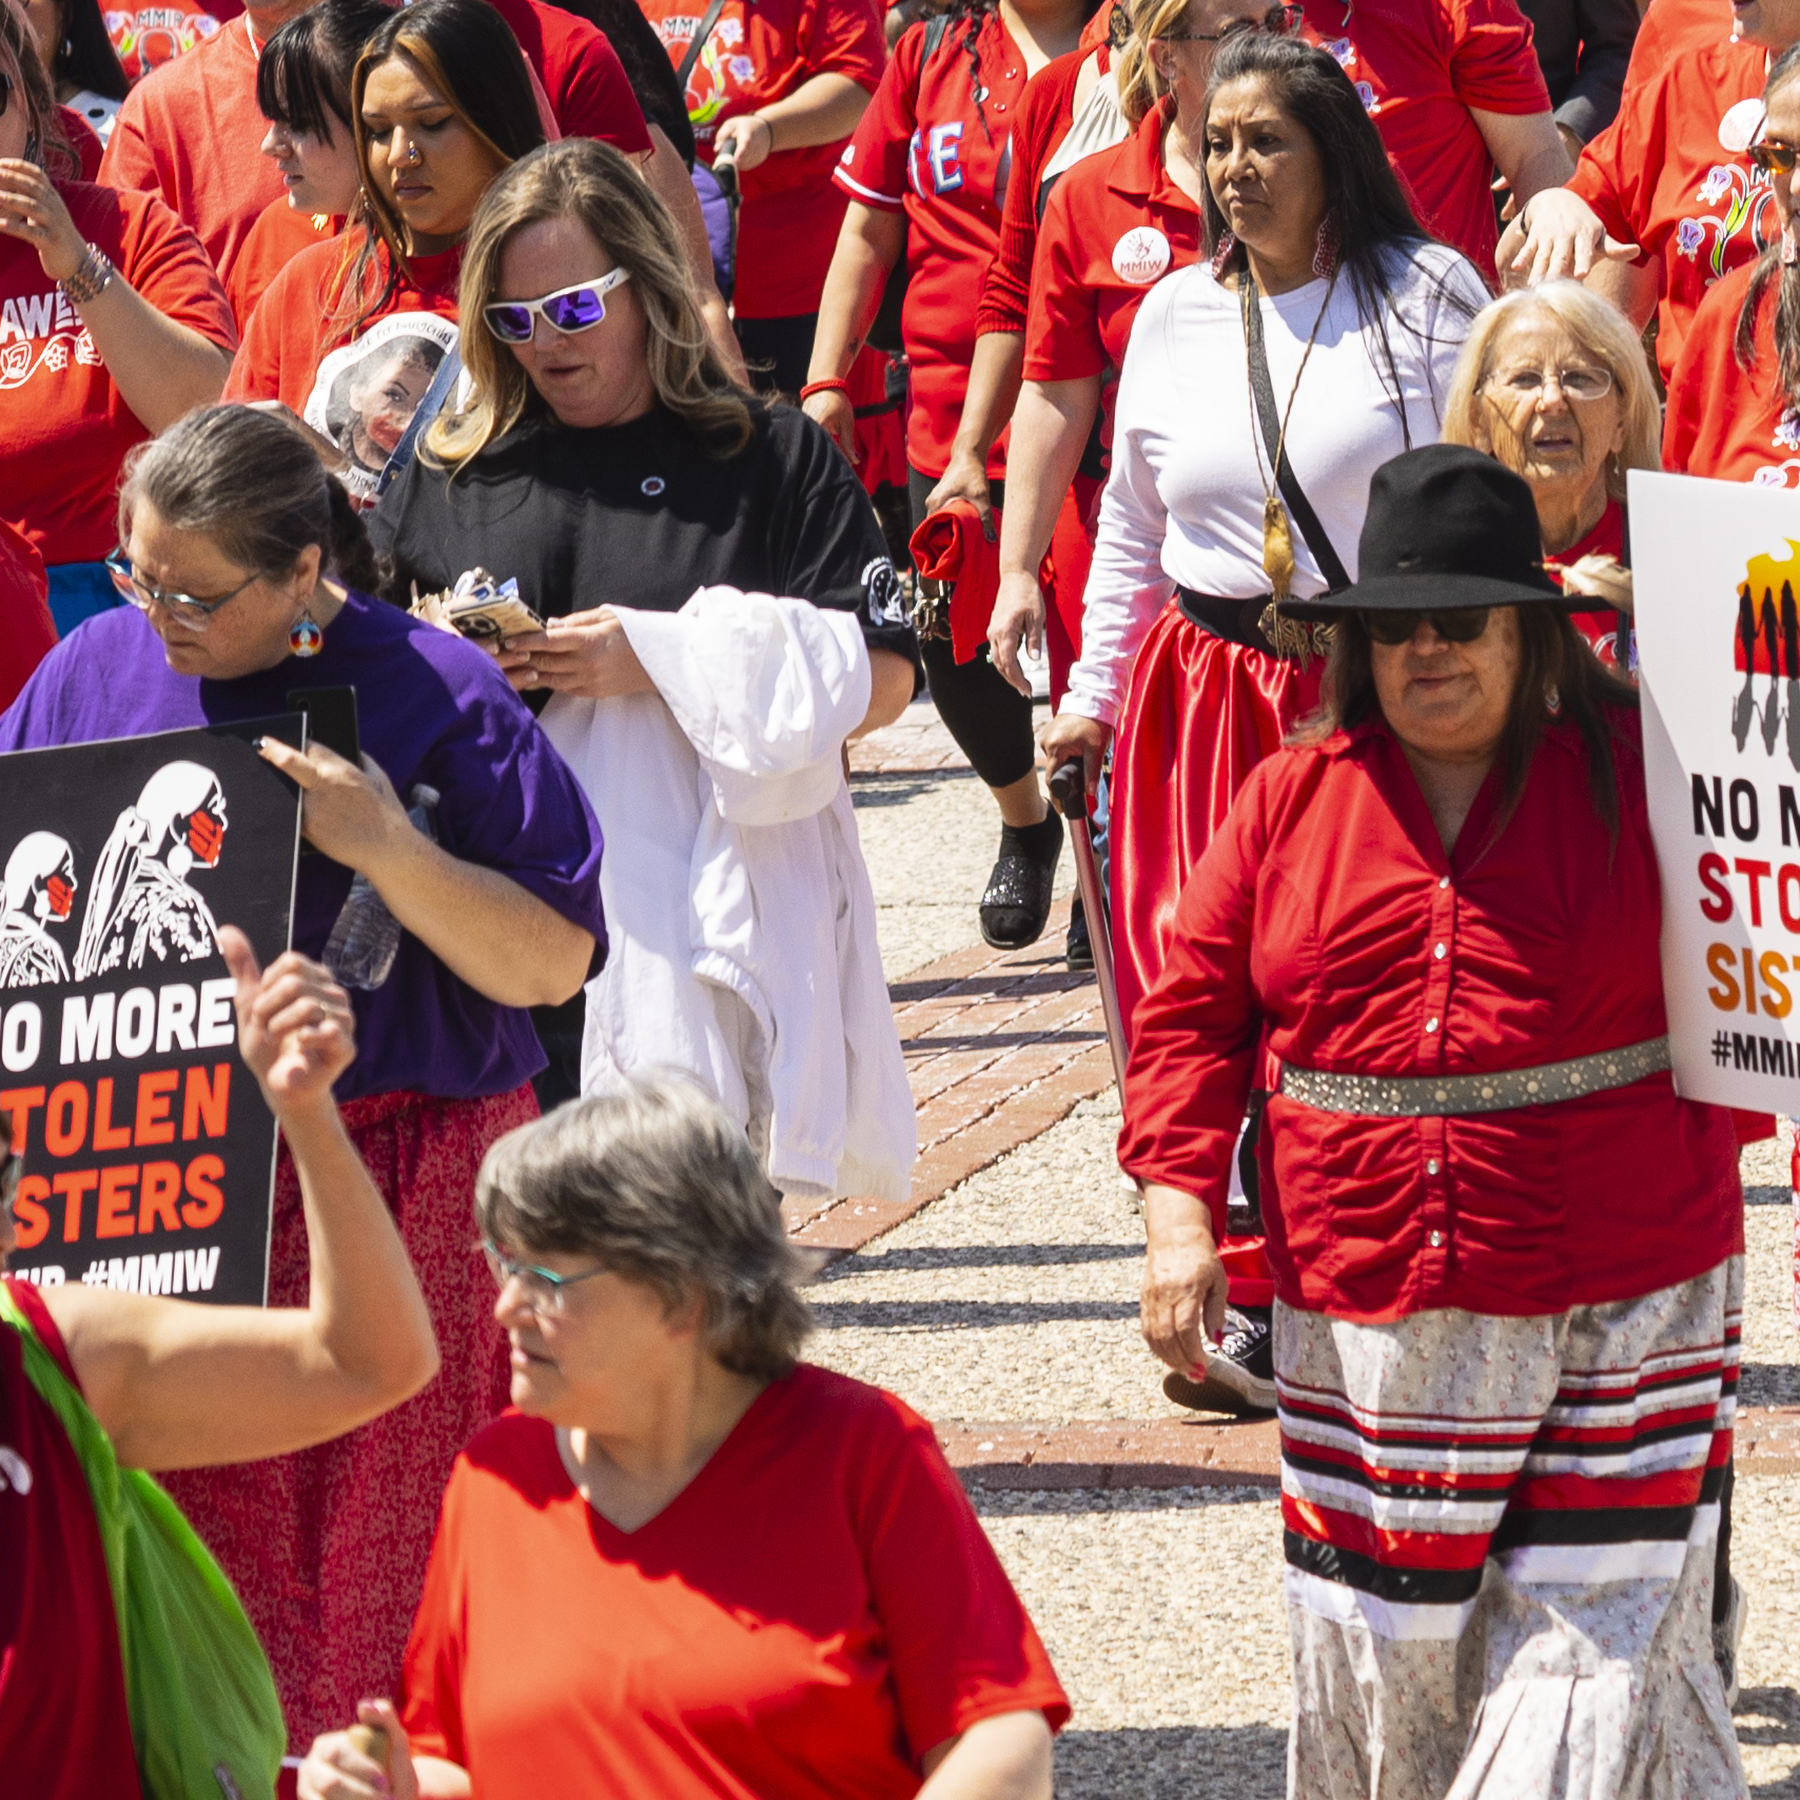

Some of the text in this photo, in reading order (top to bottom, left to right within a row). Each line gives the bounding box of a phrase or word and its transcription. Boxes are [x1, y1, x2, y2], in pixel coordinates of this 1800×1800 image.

[136, 6, 185, 29] MMIP
[1120, 259, 1162, 273] MMIW
[1692, 773, 1759, 843] NO
[59, 978, 239, 1066] MORE
[0, 1062, 232, 1159] TOLEN
[13, 1154, 226, 1249] STERS
[81, 1246, 221, 1296] #MMIW
